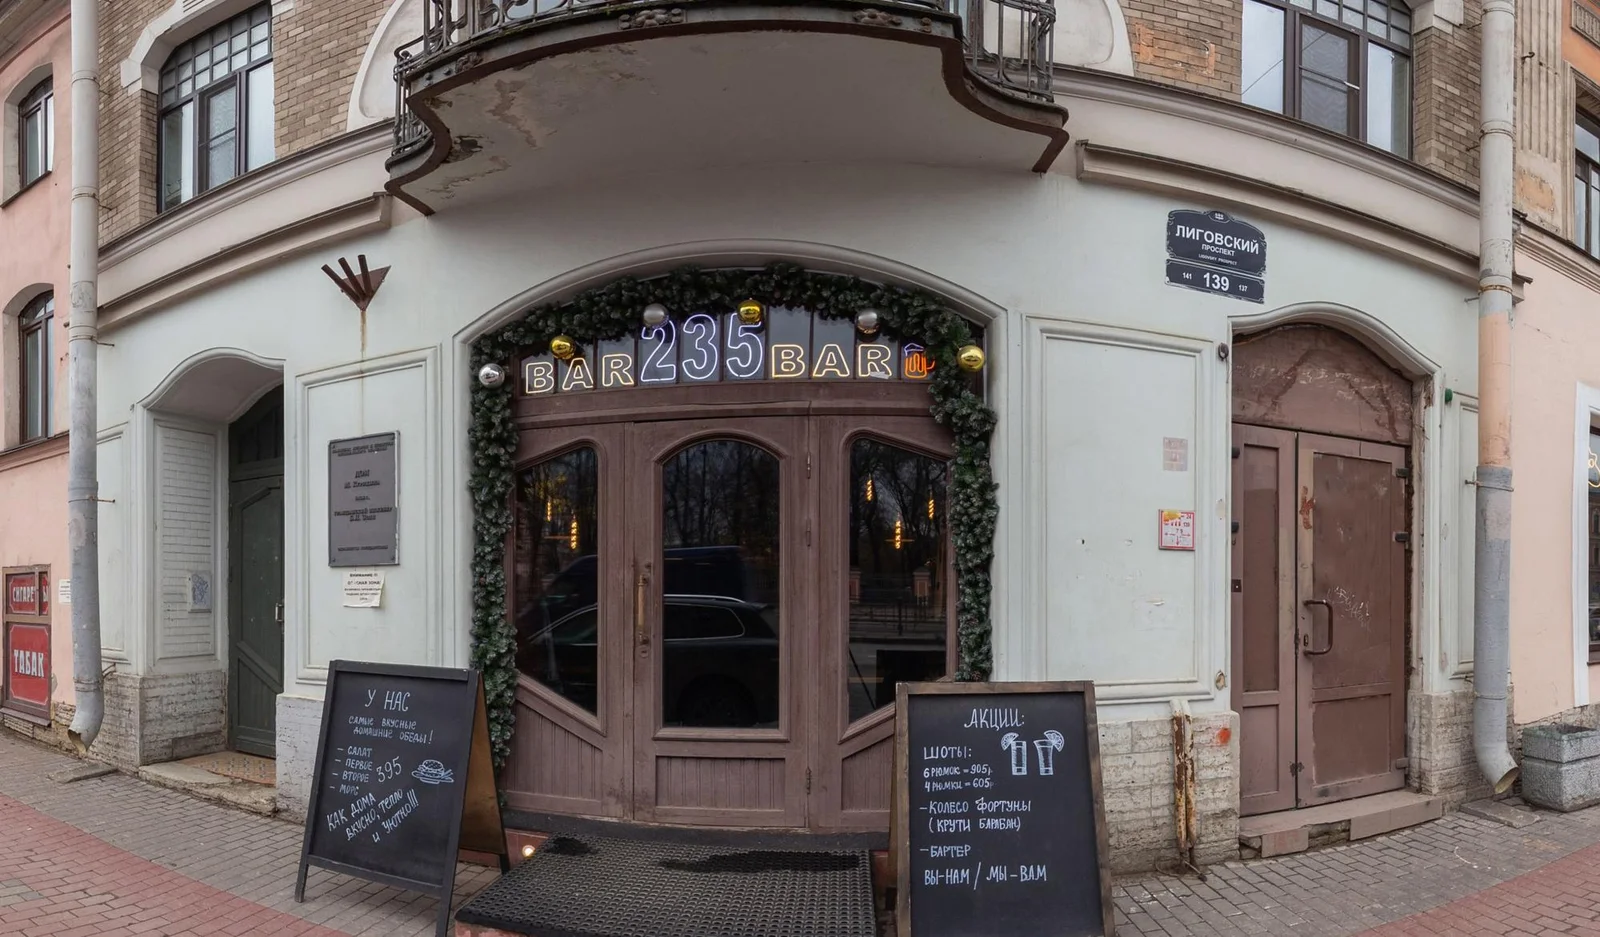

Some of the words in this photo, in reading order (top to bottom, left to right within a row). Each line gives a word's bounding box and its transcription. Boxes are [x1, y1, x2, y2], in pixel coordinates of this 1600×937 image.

[1175, 224, 1259, 254] ЛИГОВСКИЙ
[1201, 243, 1236, 257] ПРОСПЕКТ
[1182, 272, 1192, 280] 141
[1203, 272, 1230, 292] 139
[1238, 284, 1248, 292] 137
[525, 353, 634, 394] BAR
[641, 313, 763, 382] 235
[772, 343, 893, 378] BAR
[13, 649, 45, 678] ТАБАК
[364, 689, 377, 707] У
[383, 690, 411, 712] НАС
[348, 715, 374, 726] САМЫЕ
[381, 717, 417, 730] ВКУСНЫЕ
[963, 708, 1025, 731] АКЦИИ:
[353, 726, 393, 739] ДОМАШНИЕ
[347, 745, 373, 758] САЛАТ
[923, 745, 972, 760] ШОТЫ:
[345, 758, 373, 771] ПЕРВОЕ
[376, 755, 402, 783] 395
[923, 767, 930, 778] 6
[931, 766, 961, 777] РЮМОК
[342, 770, 370, 783] ВТОРОЕ
[339, 783, 359, 796] МОРС
[924, 781, 931, 792] 4
[932, 780, 963, 792] РЮМКИ
[326, 808, 348, 832] КАК
[350, 792, 377, 818] ДОМА
[975, 796, 1032, 814] ФОРТУНЫ
[345, 808, 381, 841] ВКУСНО,
[979, 816, 1021, 832] БАРАБАН)
[924, 868, 970, 886] ВЫ-НАМ
